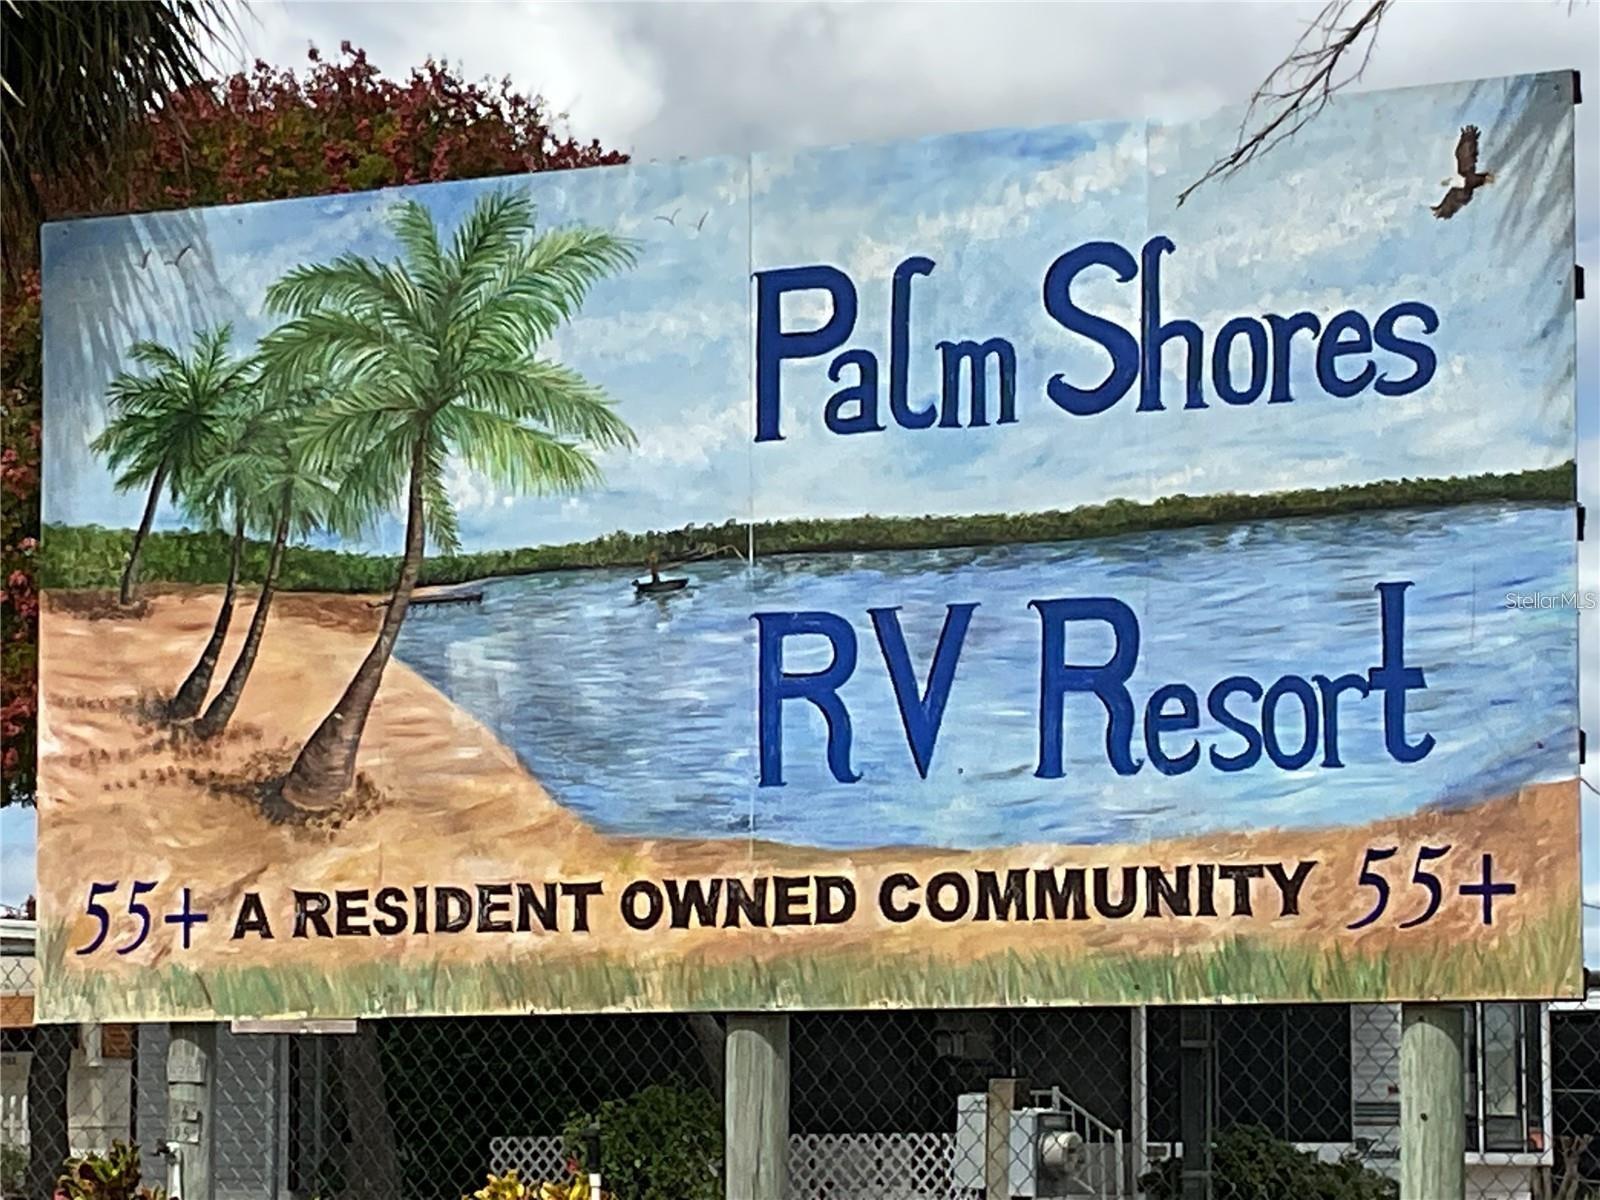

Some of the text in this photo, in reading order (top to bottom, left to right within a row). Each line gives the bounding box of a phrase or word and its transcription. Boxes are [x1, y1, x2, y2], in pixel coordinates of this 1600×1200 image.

[752, 236, 1439, 443] Palm Shores
[751, 582, 1436, 788] RV Resort
[76, 844, 1517, 955] 55+ A RESIDENT OWNED COMMUNITY 55+
